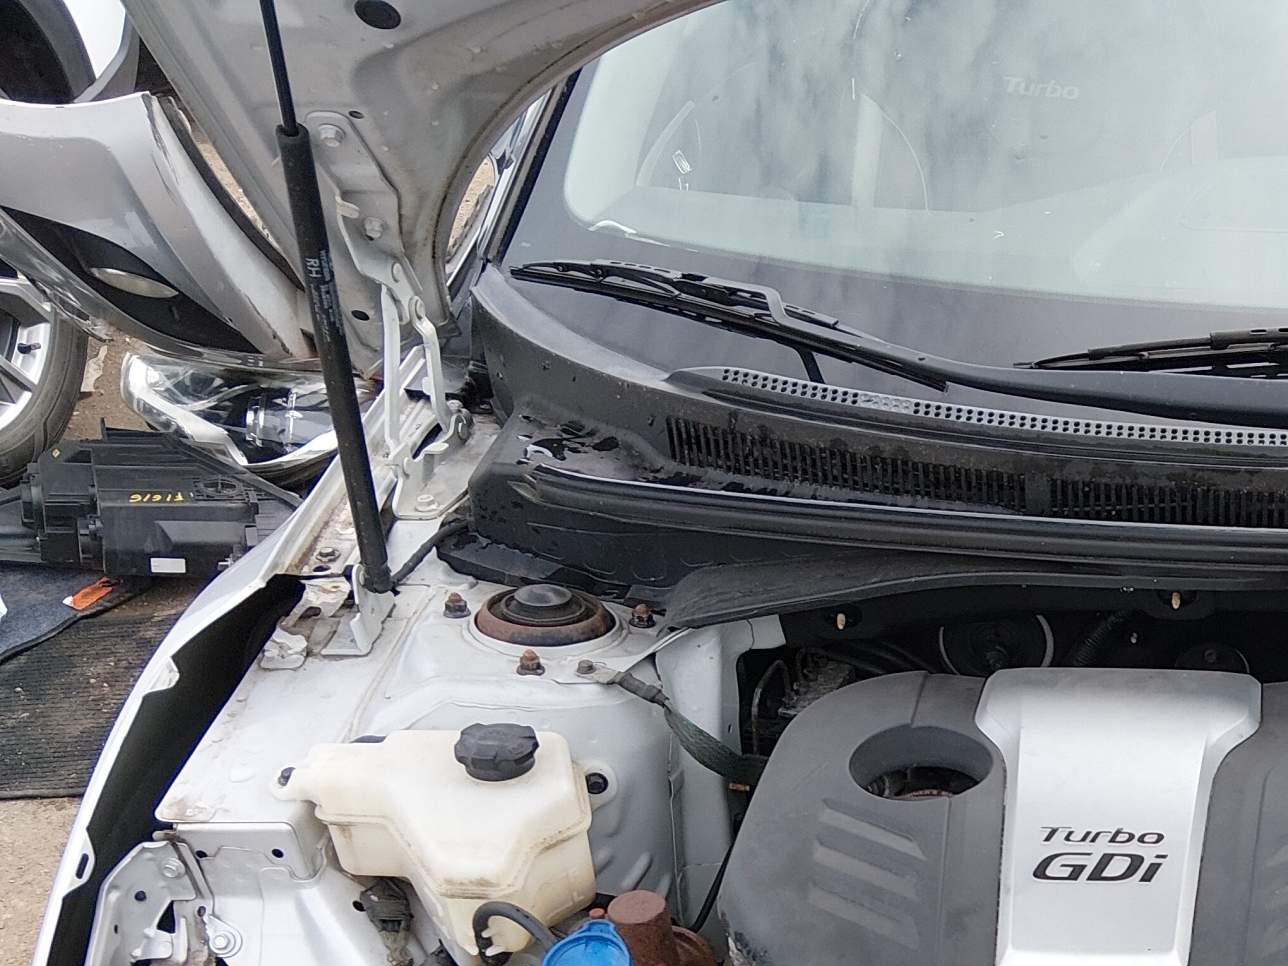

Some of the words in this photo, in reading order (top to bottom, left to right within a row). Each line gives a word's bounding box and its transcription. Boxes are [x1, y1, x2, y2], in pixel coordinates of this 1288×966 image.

[1003, 76, 1080, 100] Turbo
[305, 257, 321, 278] RH
[1040, 826, 1165, 845] Turbo
[1032, 852, 1169, 883] GDi
